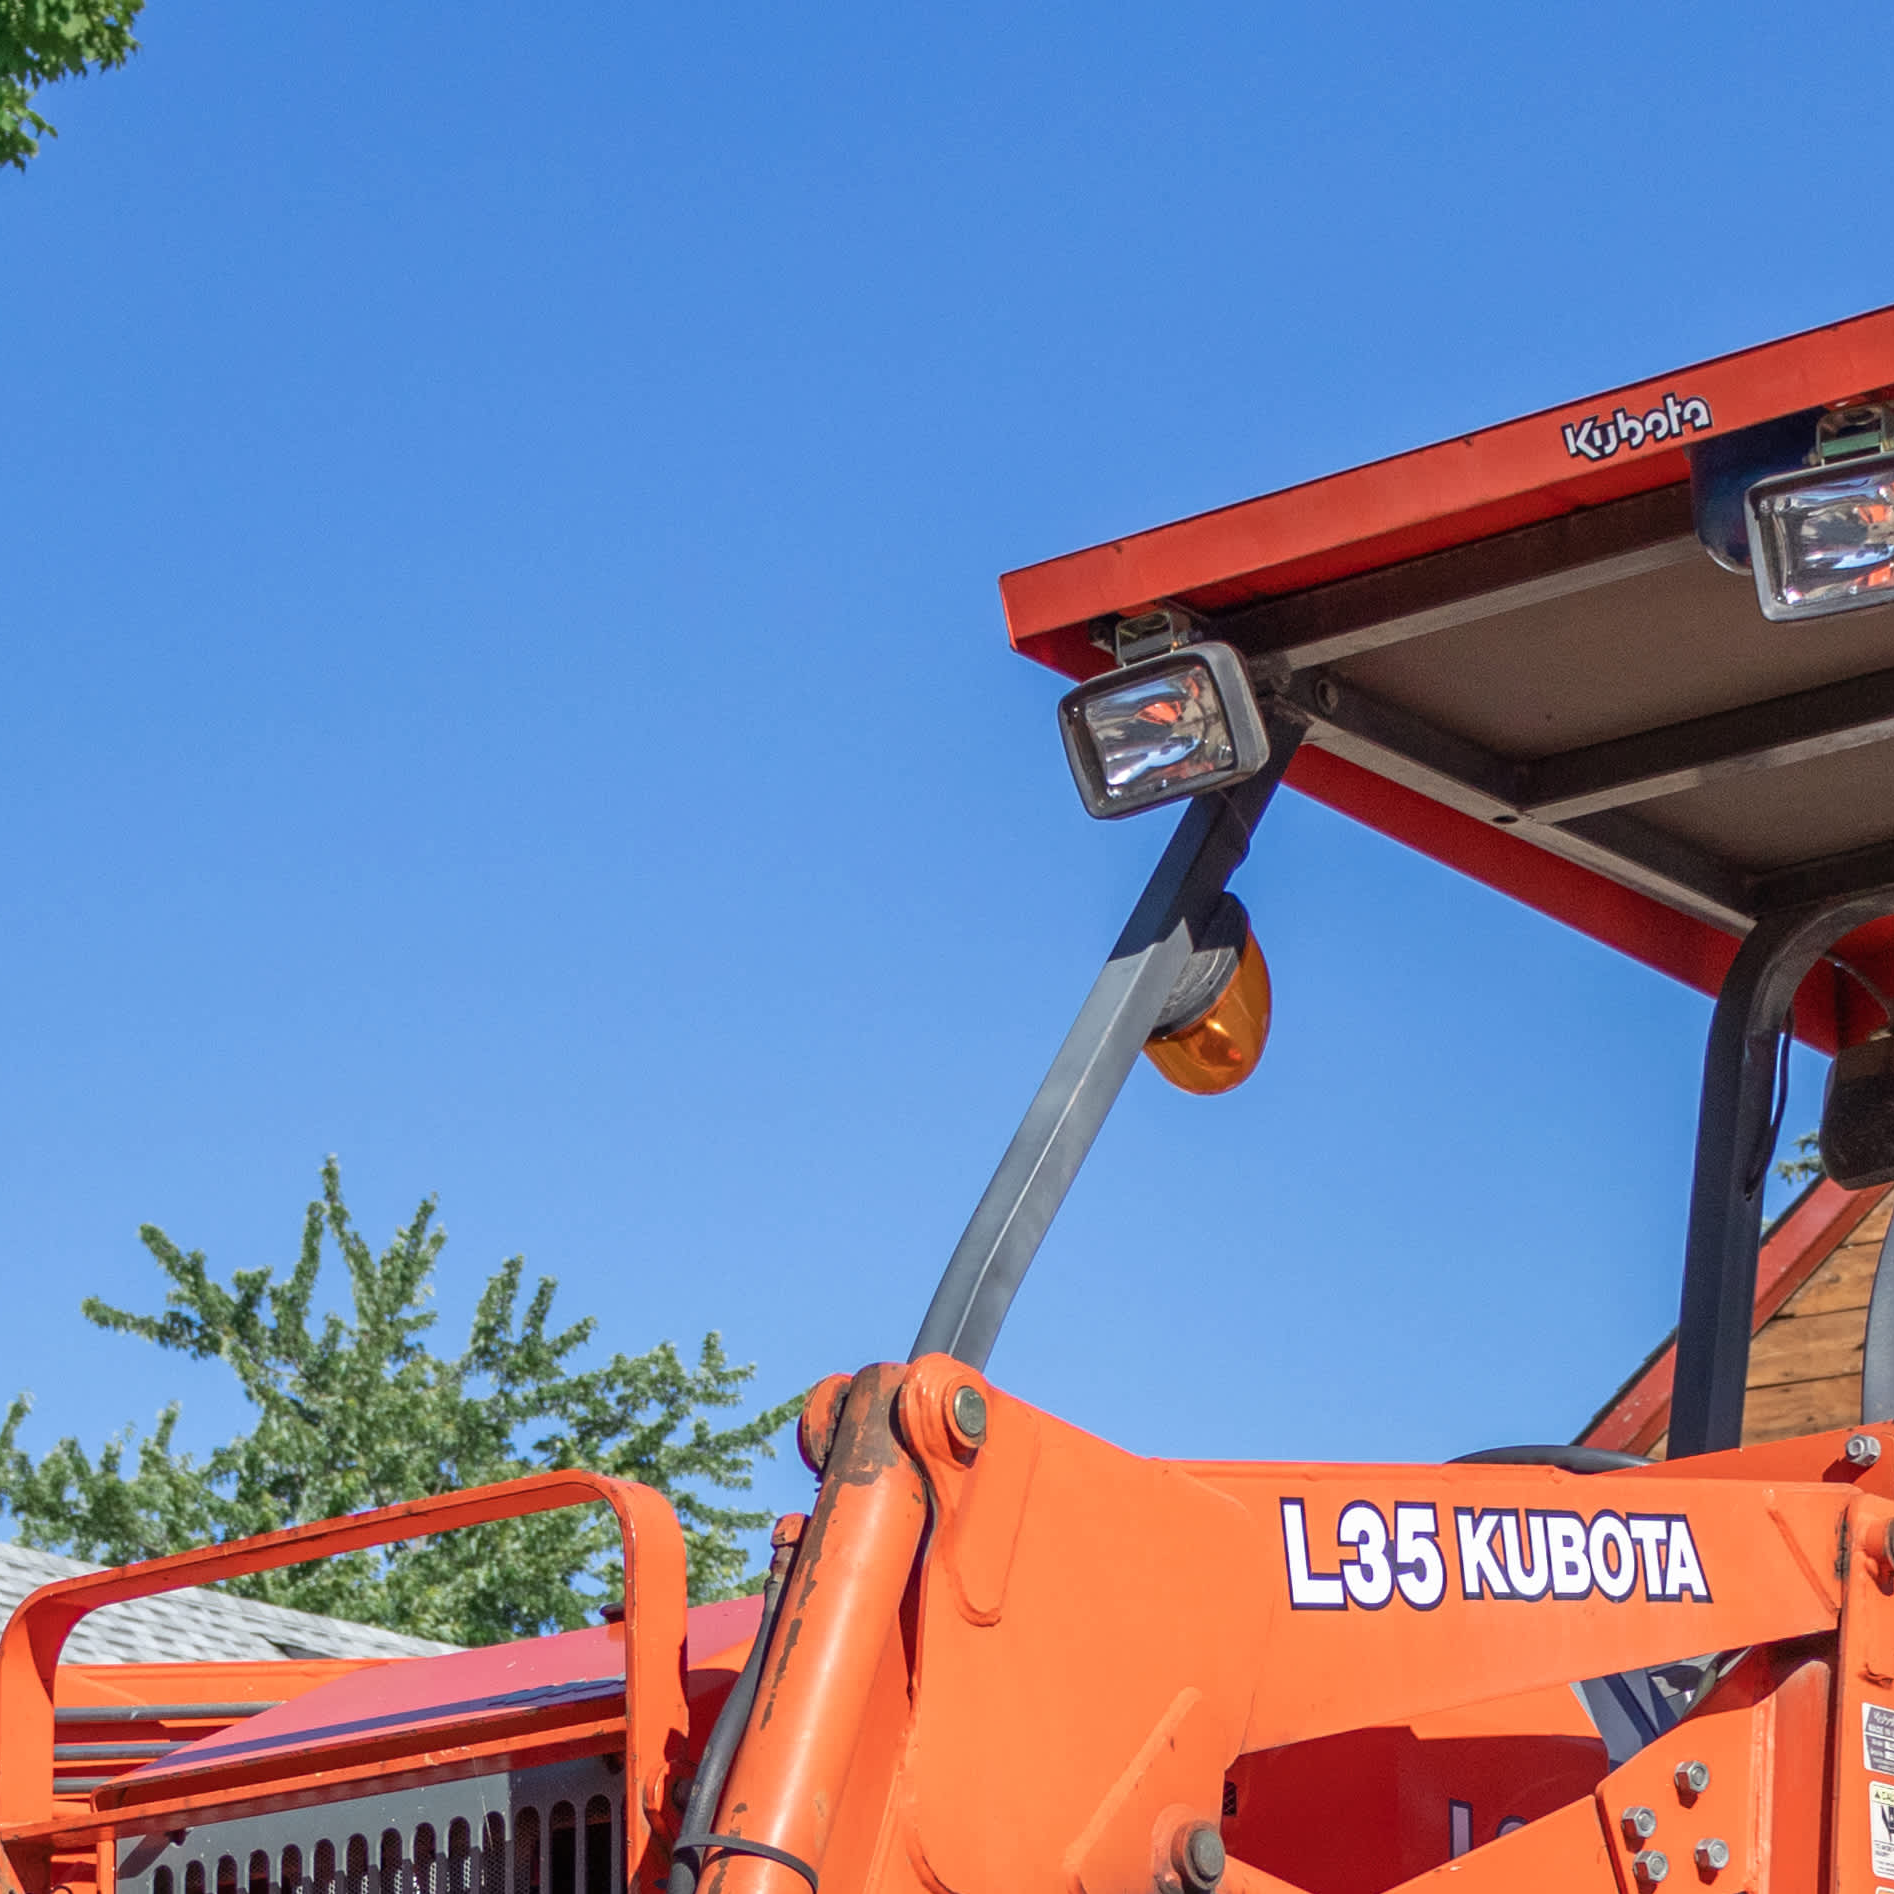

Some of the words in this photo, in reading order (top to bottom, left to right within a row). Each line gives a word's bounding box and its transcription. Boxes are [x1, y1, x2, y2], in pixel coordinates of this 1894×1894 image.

[1561, 391, 1713, 462] Kubota
[1279, 1497, 1447, 1611] L35
[1453, 1506, 1714, 1603] KUBOTA
